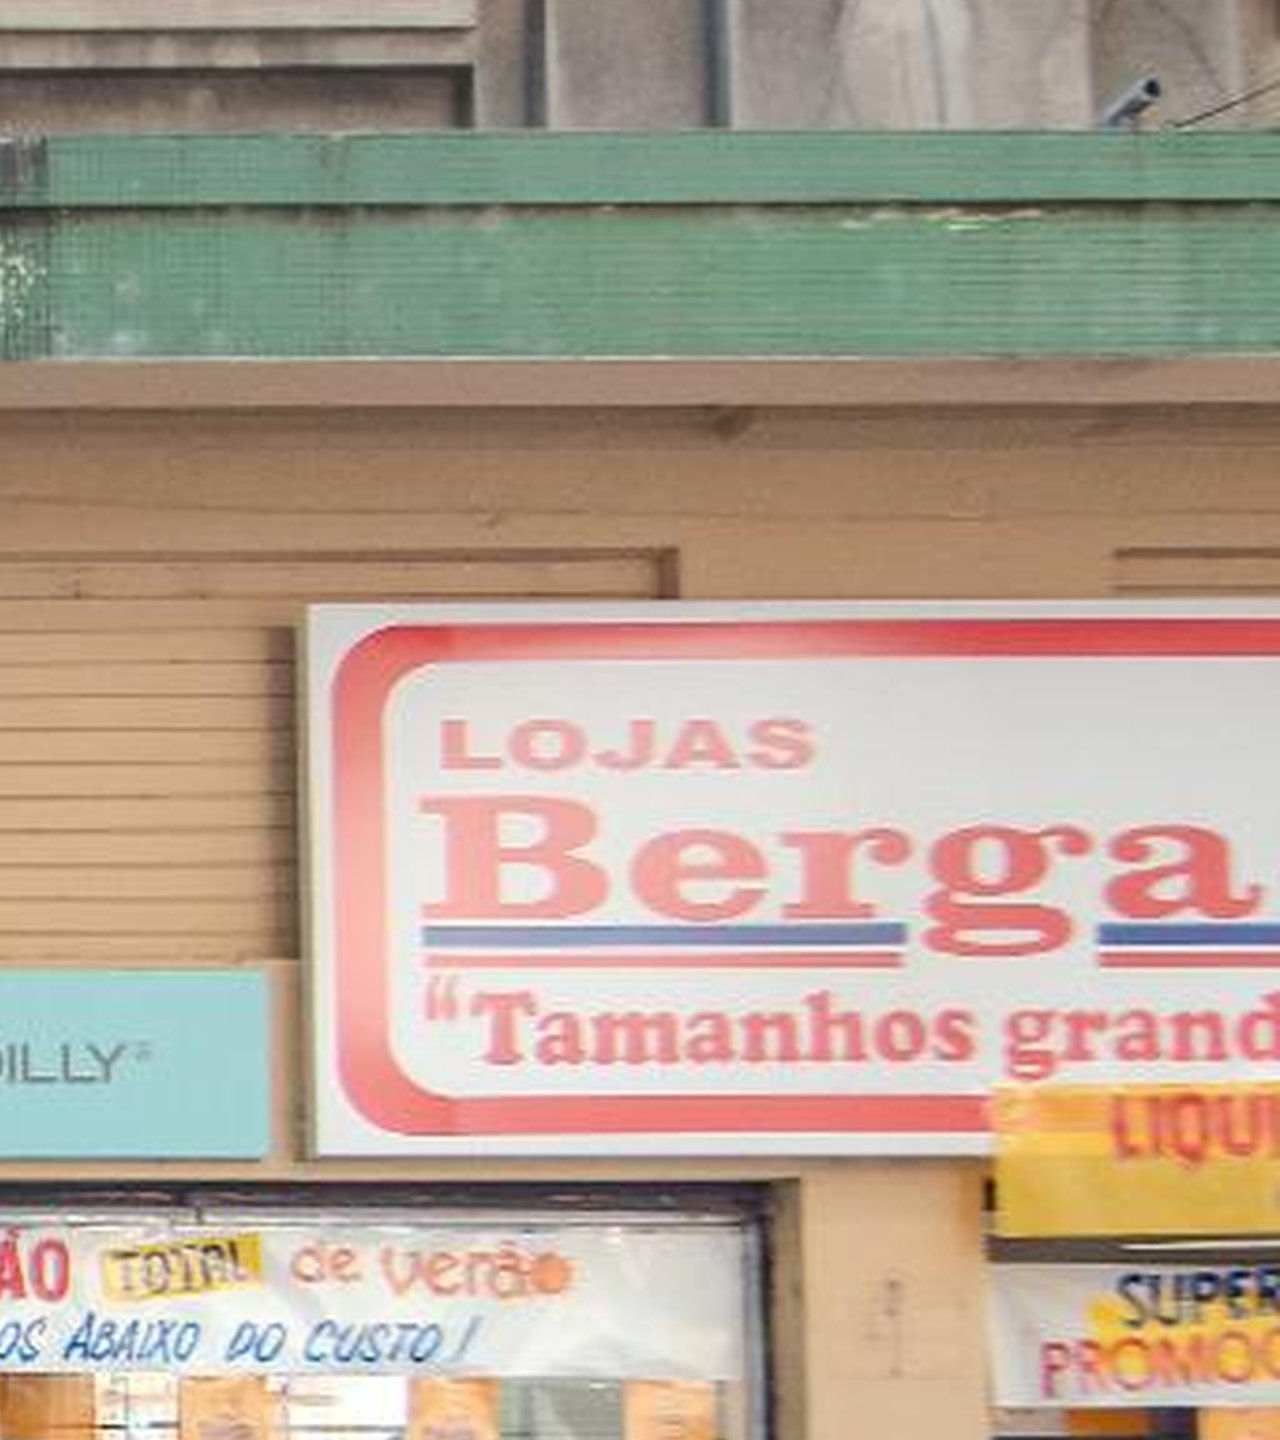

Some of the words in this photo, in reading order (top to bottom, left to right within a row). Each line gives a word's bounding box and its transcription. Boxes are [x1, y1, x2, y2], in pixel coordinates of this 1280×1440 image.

[441, 718, 816, 772] LOJAS
[418, 793, 1264, 958] Berga
[112, 1240, 250, 1296] TOTAL
[289, 1240, 363, 1284] de
[62, 1311, 201, 1363] ABAIXO
[225, 1322, 288, 1363] DO
